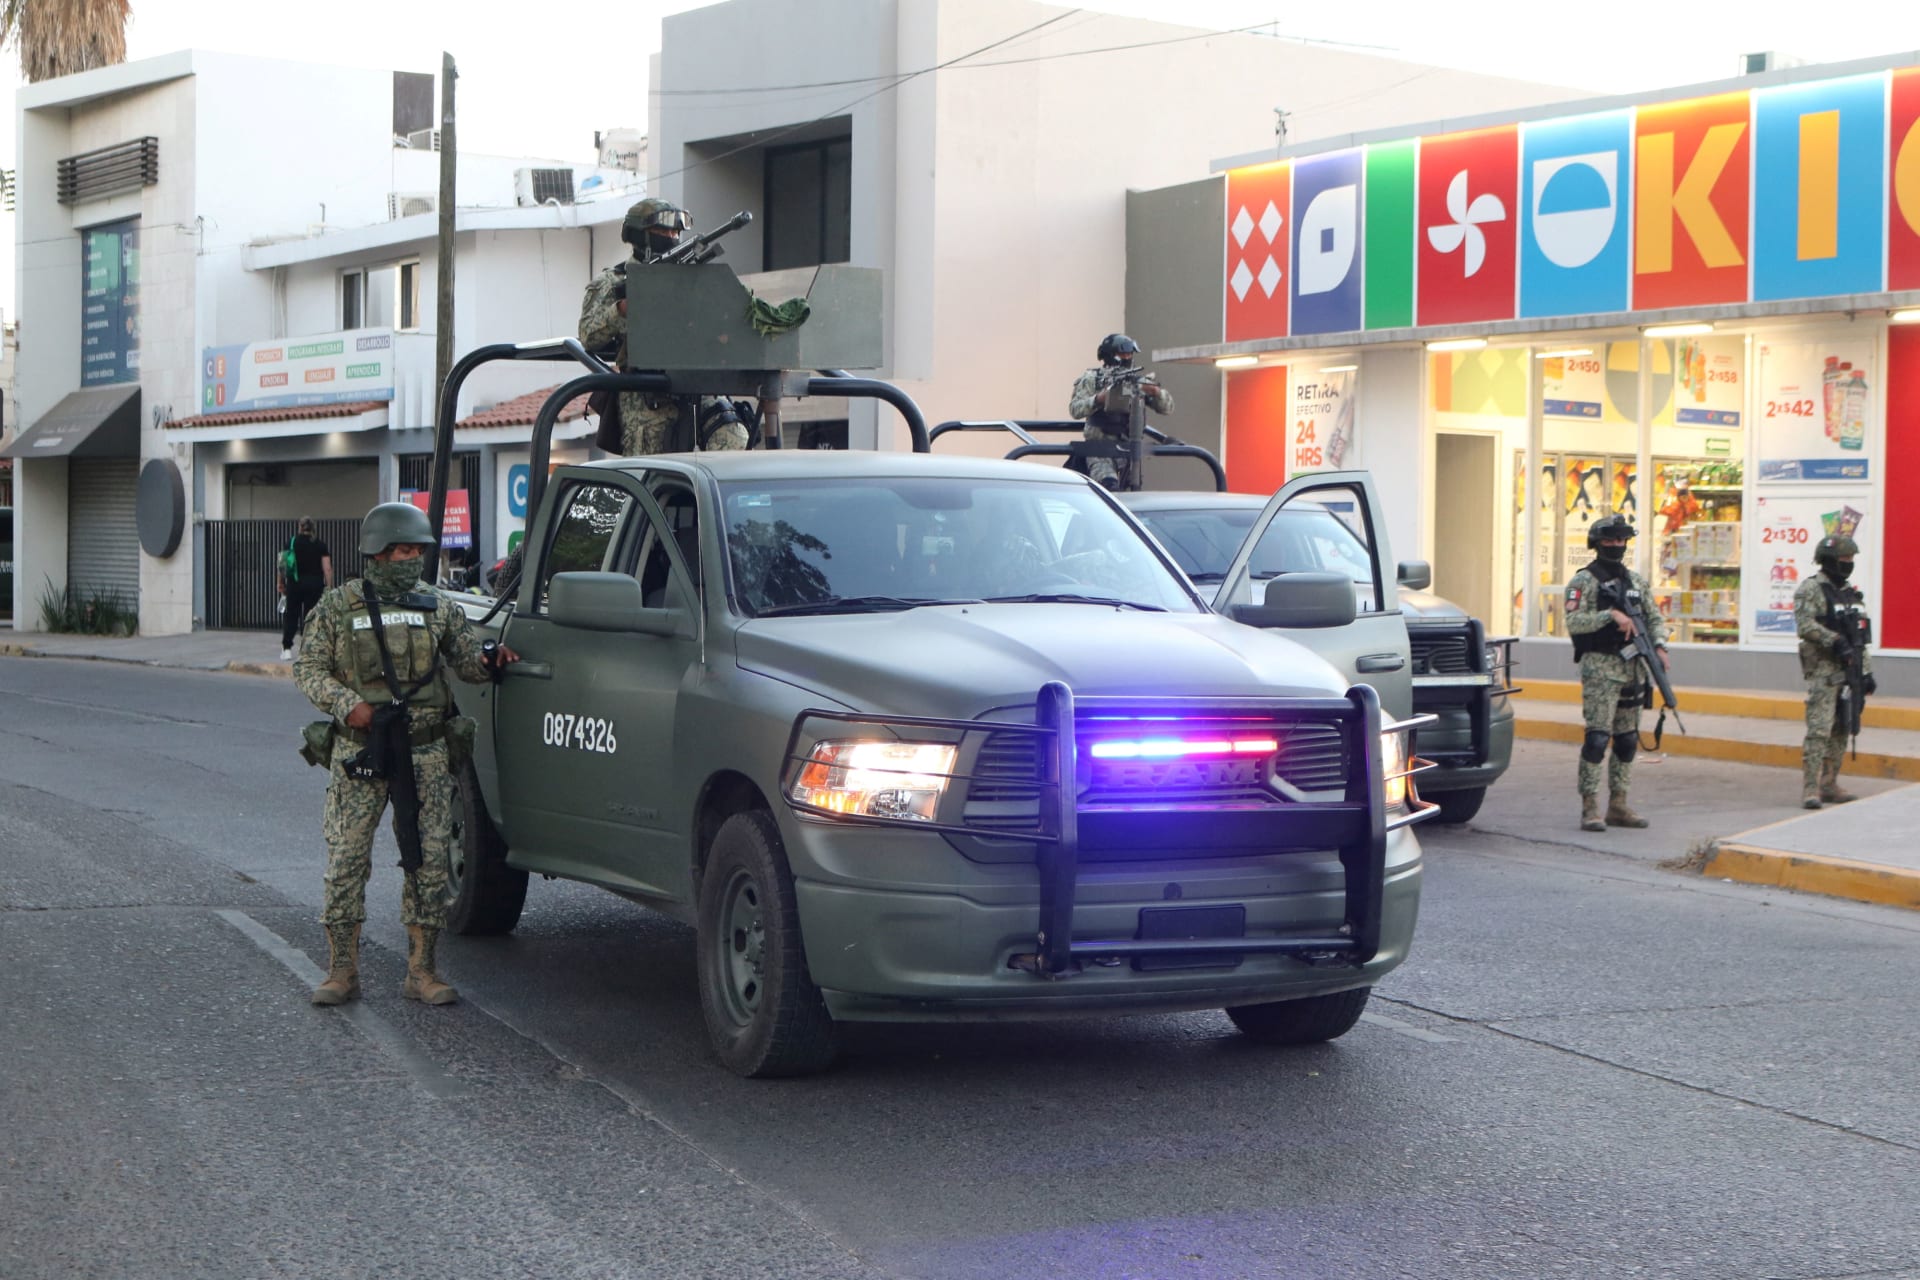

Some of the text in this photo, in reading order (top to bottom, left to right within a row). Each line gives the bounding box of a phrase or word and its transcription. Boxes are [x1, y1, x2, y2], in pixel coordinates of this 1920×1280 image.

[1635, 109, 1920, 275] KI
[1765, 399, 1815, 418] 2x$42
[1295, 419, 1316, 444] 24
[1295, 446, 1322, 467] HRS
[1762, 527, 1809, 544] 2x$30
[353, 612, 425, 630] EJRCITO
[543, 712, 617, 754] 0874326
[1110, 759, 1261, 788] RAM
